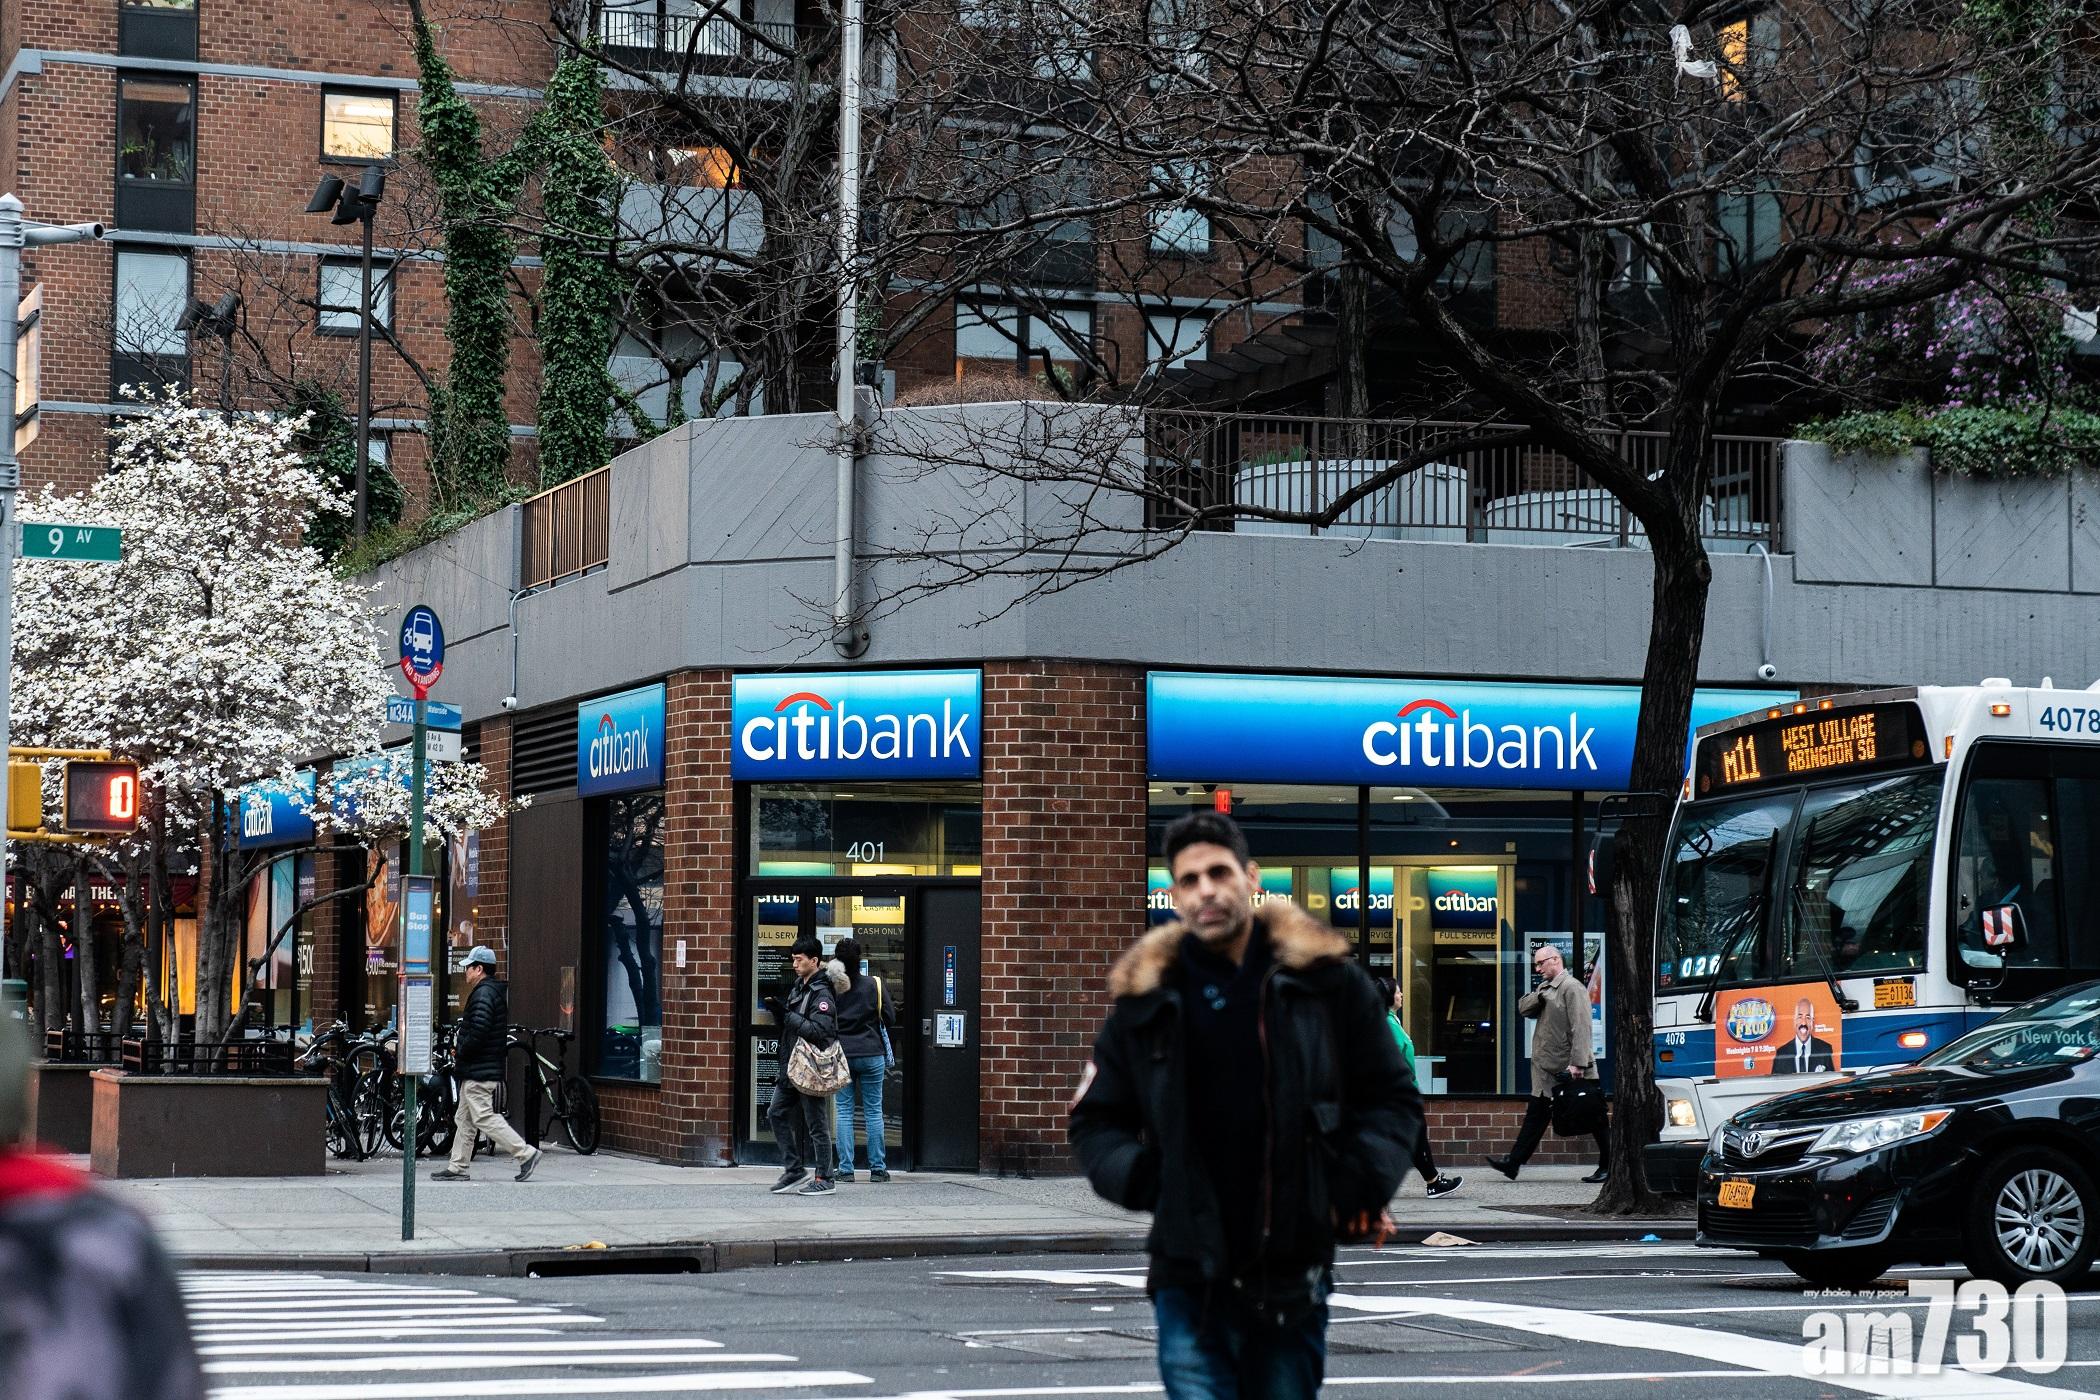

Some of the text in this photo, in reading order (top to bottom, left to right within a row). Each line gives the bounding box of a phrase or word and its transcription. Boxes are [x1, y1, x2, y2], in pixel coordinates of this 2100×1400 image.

[48, 528, 93, 555] 9 AV
[405, 661, 440, 685] NO STANDING
[390, 704, 414, 723] M34A
[2040, 706, 2100, 733] 4078
[741, 697, 972, 761] citibank
[1781, 713, 1876, 752] WEST VILLAGE
[589, 714, 649, 778] citibank
[1362, 708, 1598, 771] citibank
[1723, 735, 1761, 783] M11
[1788, 737, 1876, 772] ABINGDON SQ
[110, 775, 133, 818] 10
[845, 841, 885, 863] 401
[1434, 892, 1498, 912] citiban
[409, 911, 429, 921] Bus
[407, 921, 429, 932] Stop
[757, 931, 797, 940] ULL SERV
[857, 927, 904, 936] CASH ONLY
[1371, 931, 1394, 940] RVICE
[1439, 931, 1496, 940] FULL SERVICE
[1896, 985, 1913, 1000] 1136
[1728, 1002, 1773, 1022] FAMILY
[1665, 1032, 1685, 1045] 4078
[1735, 1018, 1769, 1039] FEUD
[2022, 1030, 2052, 1044] New
[2055, 1030, 2084, 1045] York
